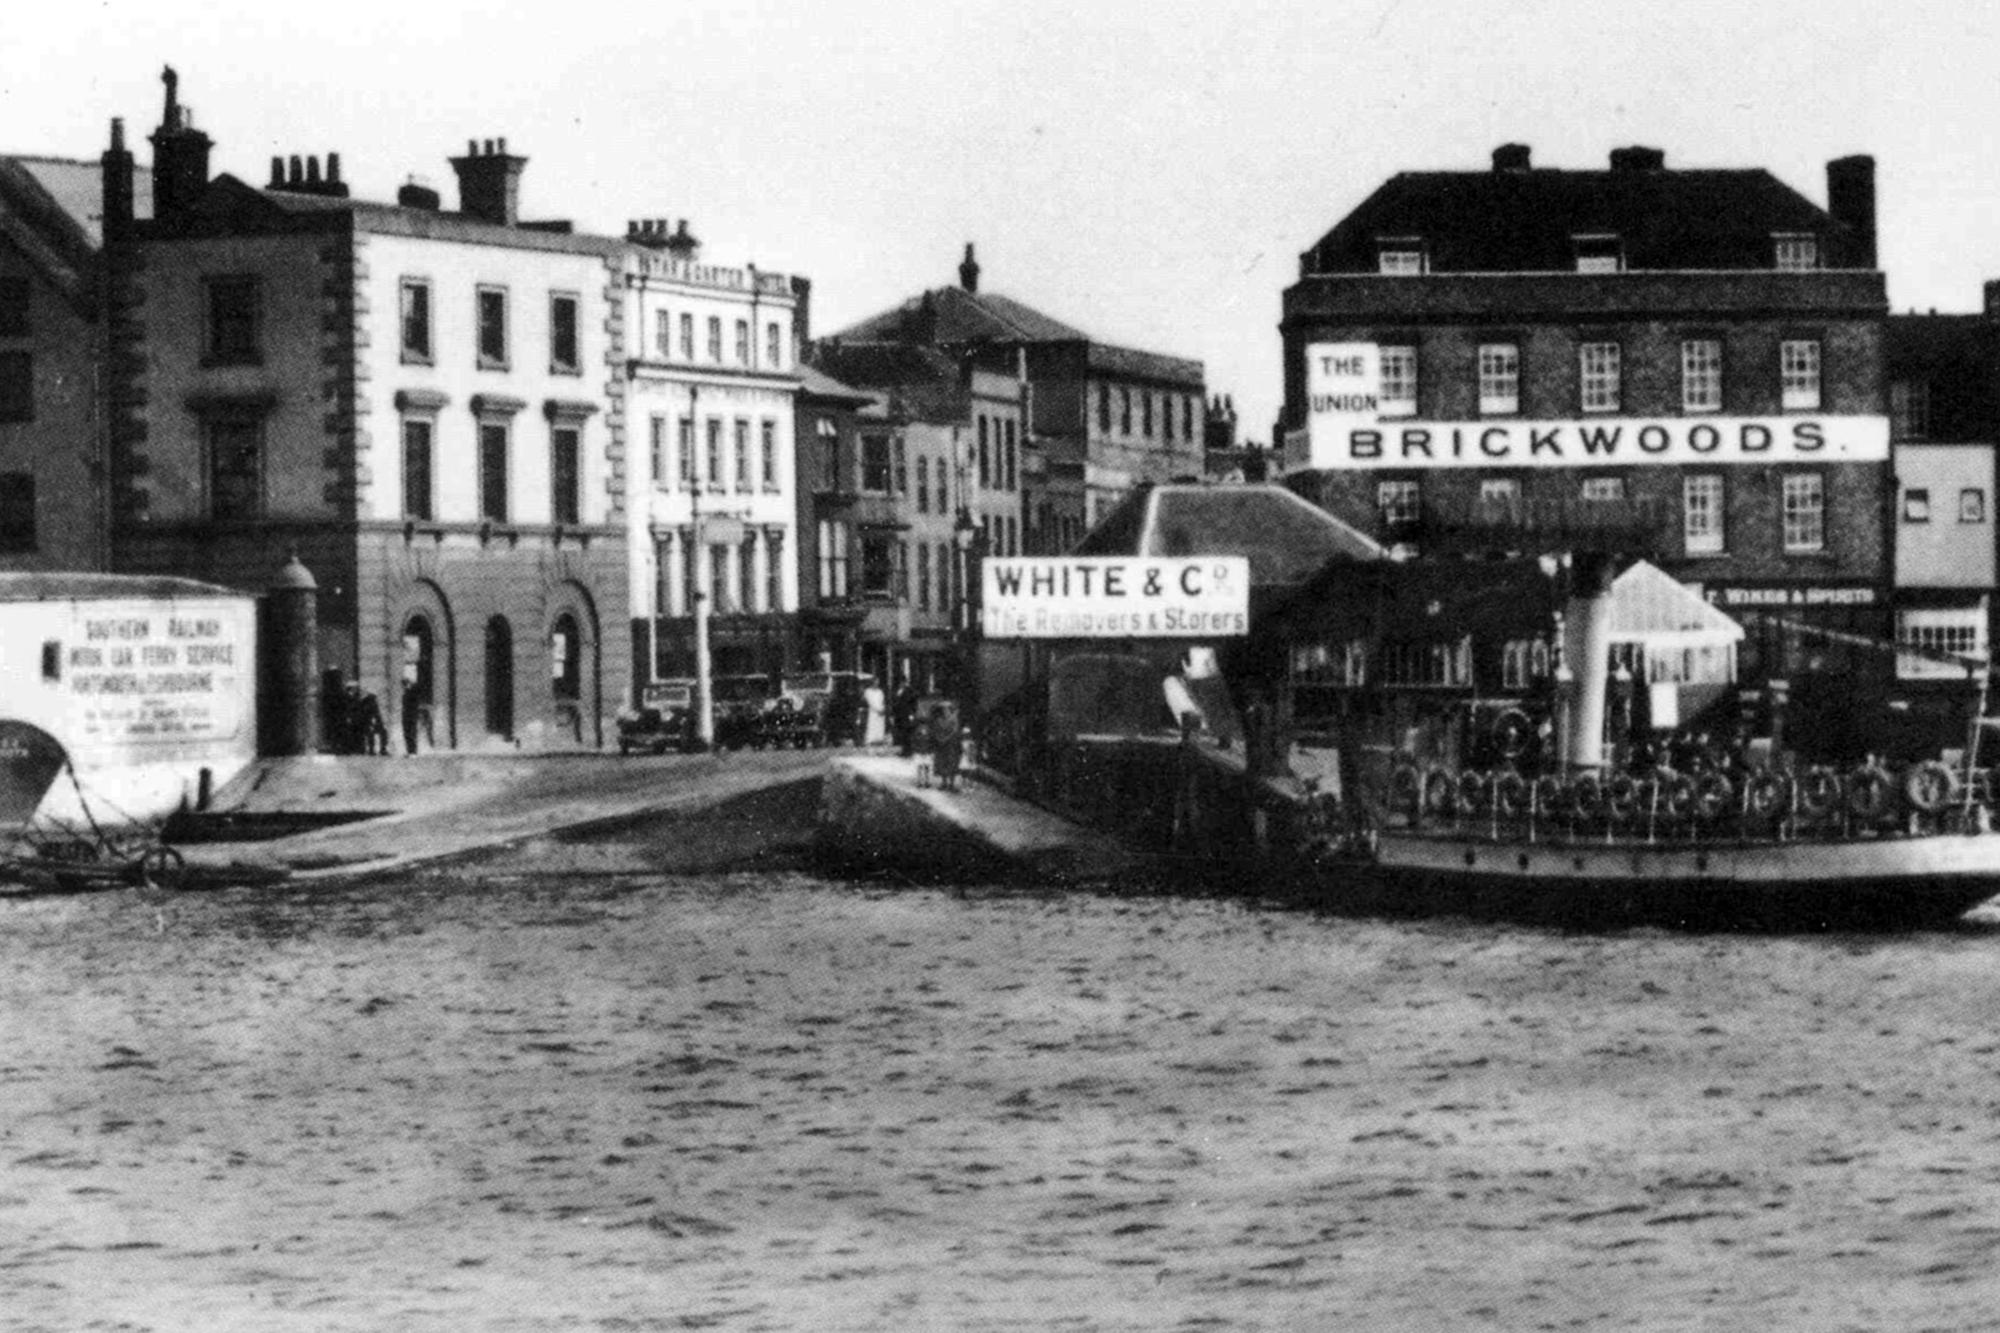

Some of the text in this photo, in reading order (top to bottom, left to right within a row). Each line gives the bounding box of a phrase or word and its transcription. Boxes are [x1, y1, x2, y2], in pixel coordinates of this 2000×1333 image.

[1320, 356, 1366, 376] THE
[1312, 392, 1378, 413] UNION
[995, 564, 1126, 597] WHITE
[1143, 566, 1162, 596] &
[86, 618, 150, 640] SOUTHERN
[990, 607, 1245, 633] The Removers & Storers
